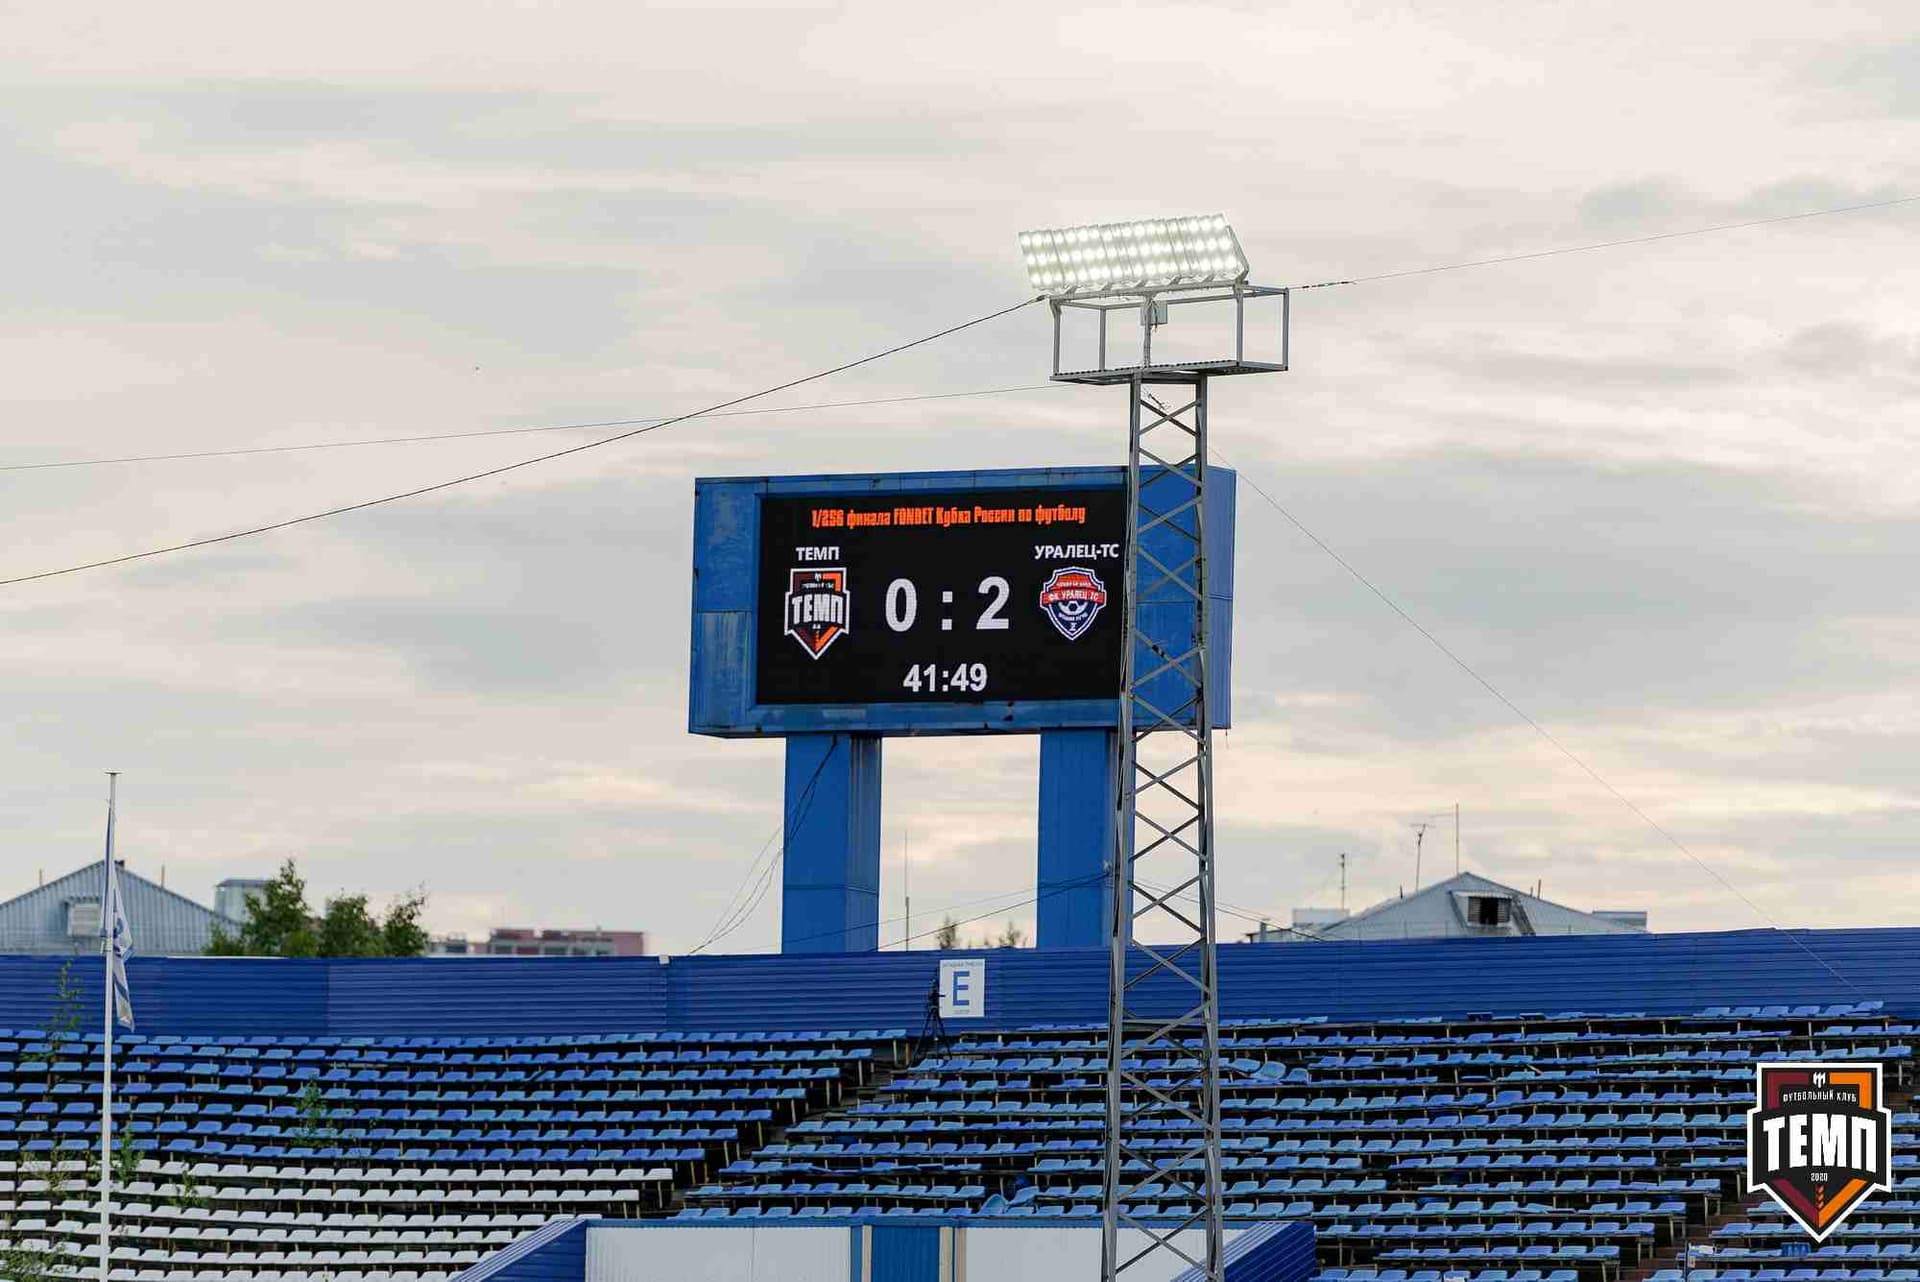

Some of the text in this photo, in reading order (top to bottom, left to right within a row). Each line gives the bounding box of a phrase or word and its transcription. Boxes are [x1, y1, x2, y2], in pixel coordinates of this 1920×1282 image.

[811, 504, 1086, 529] 1/256 финала FONBET Кубка России по футболу
[795, 546, 840, 561] ТЕМП
[1034, 544, 1120, 560] УРАЛЕЦ-ТС
[791, 593, 844, 625] ТЕМП
[885, 578, 917, 632] 0
[976, 576, 1010, 630] 2
[903, 662, 988, 693] 41:49
